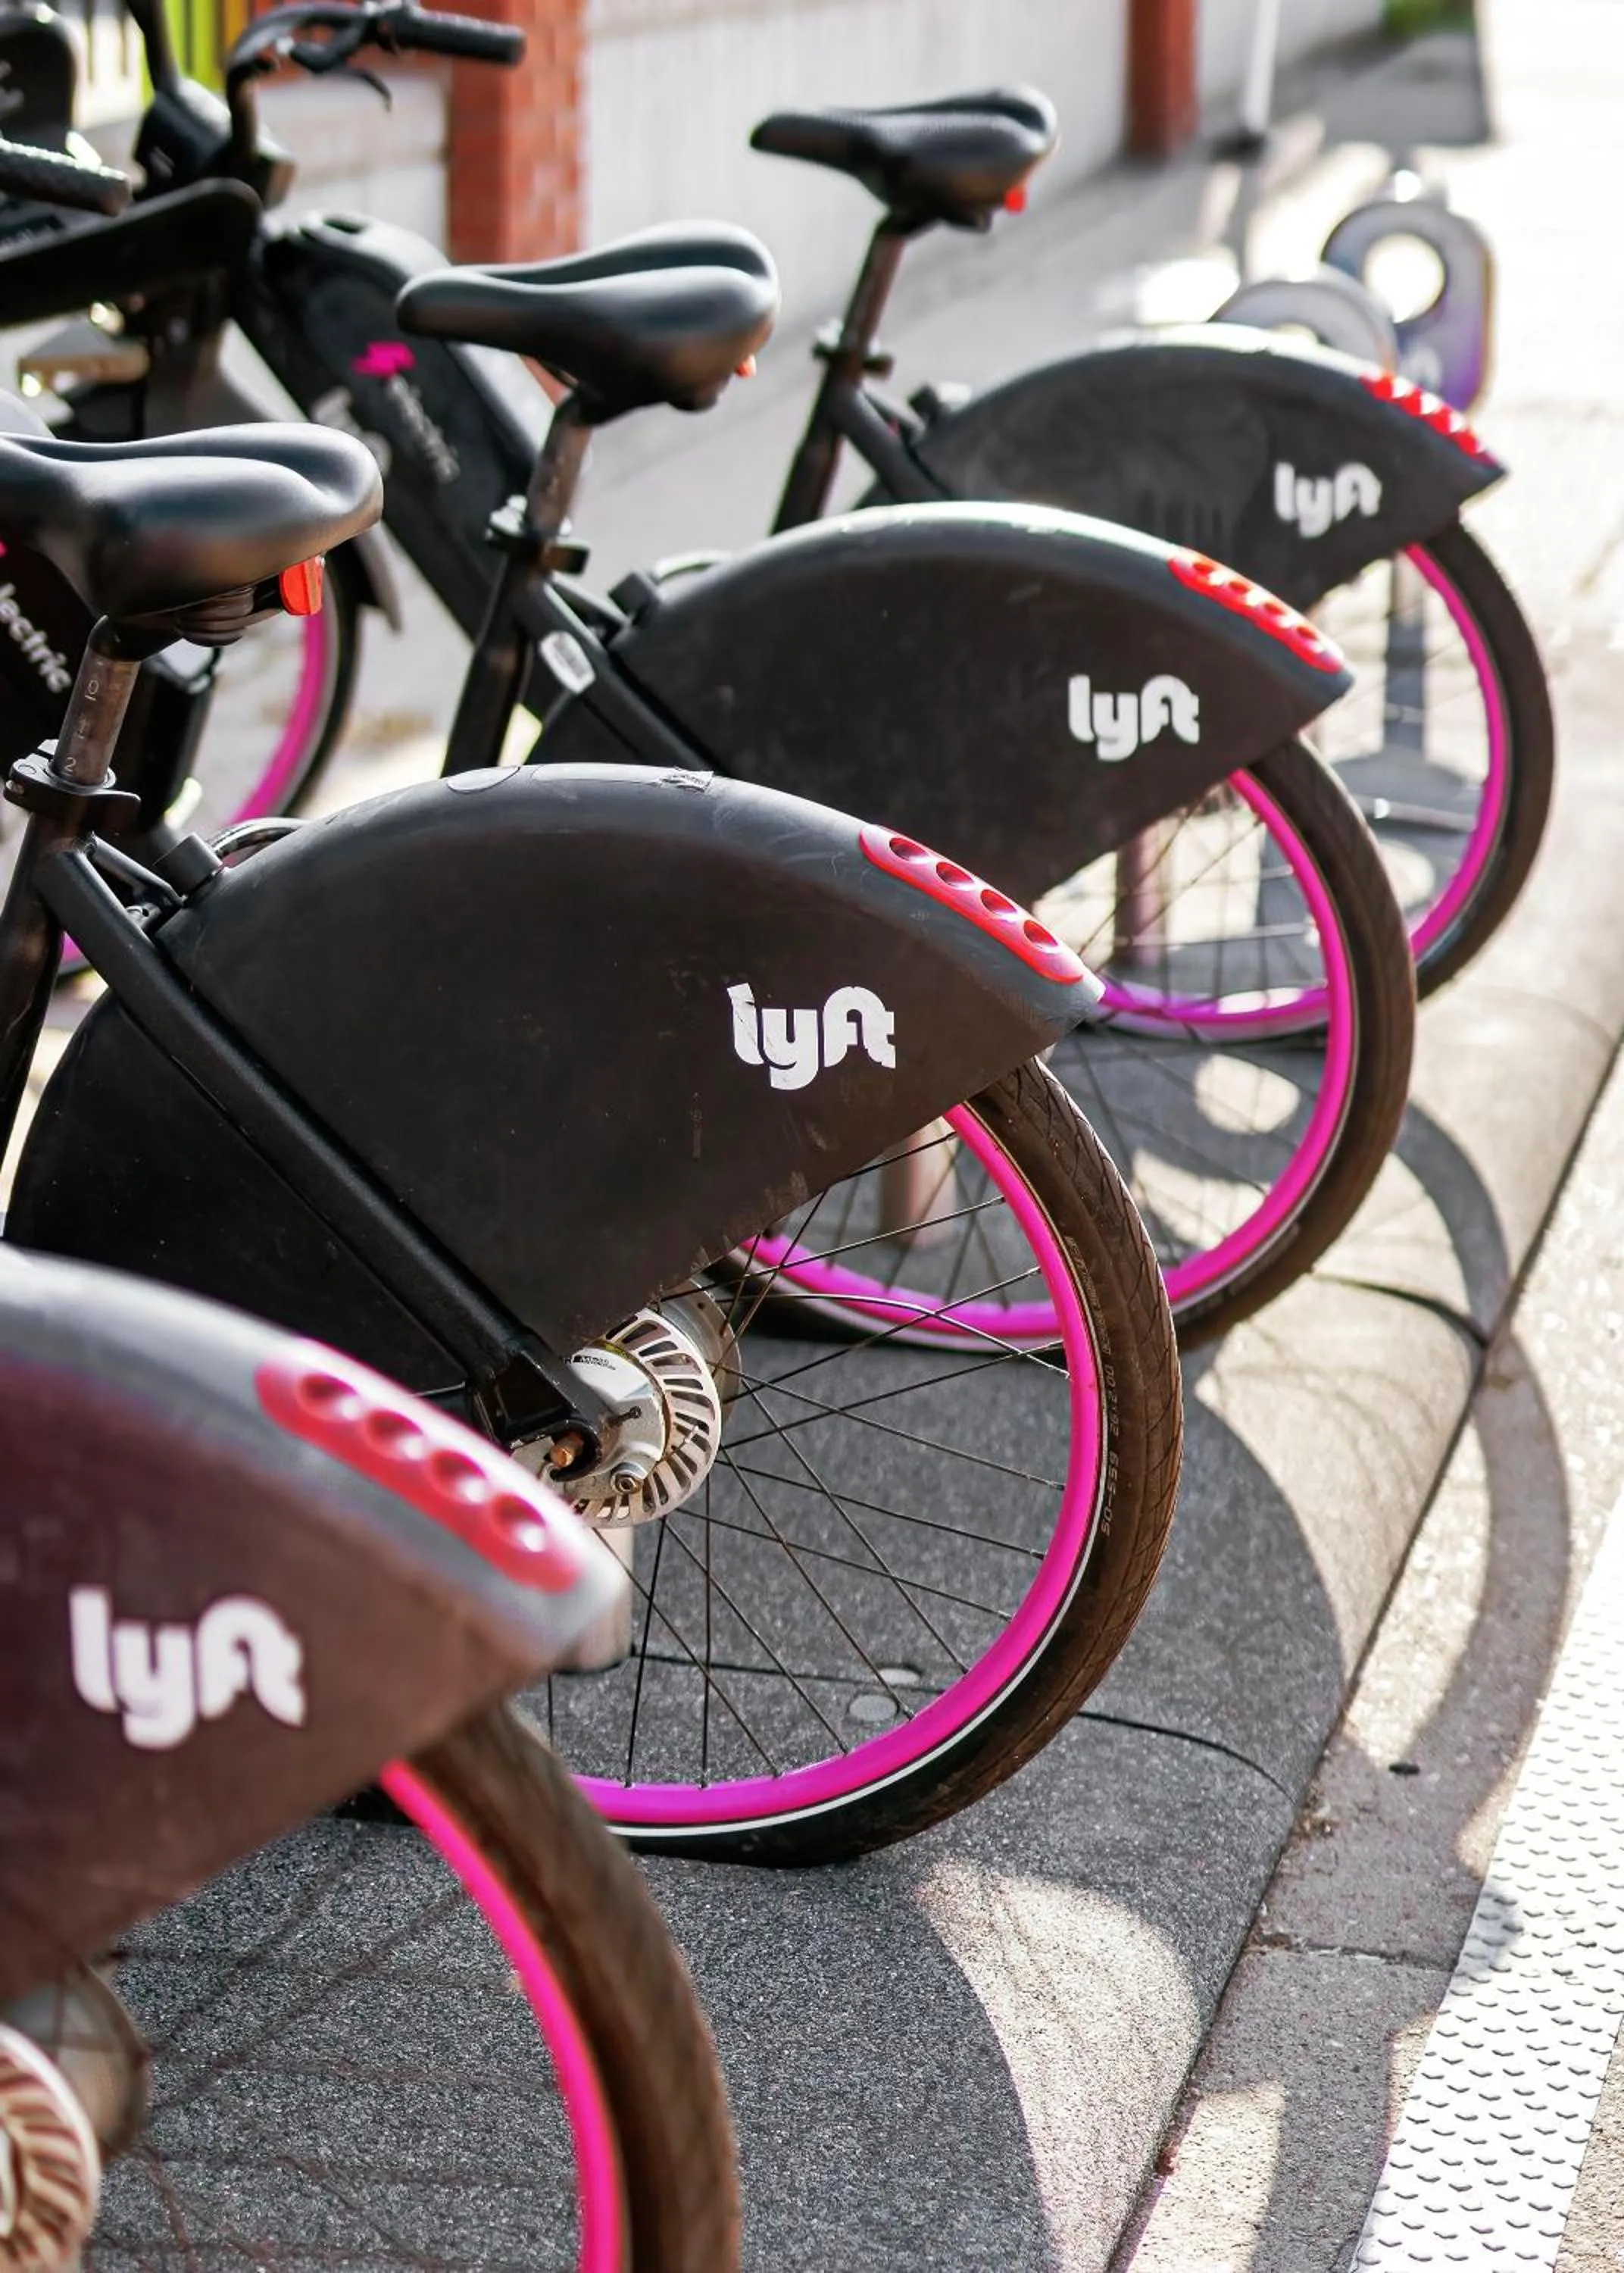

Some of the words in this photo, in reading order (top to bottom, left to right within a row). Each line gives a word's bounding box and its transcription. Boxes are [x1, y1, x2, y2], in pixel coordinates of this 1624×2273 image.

[1275, 461, 1382, 538] lyft
[0, 582, 72, 693] lectric
[1069, 674, 1200, 761] lyft
[727, 983, 896, 1090] lyft
[69, 1585, 306, 1749] lyft
